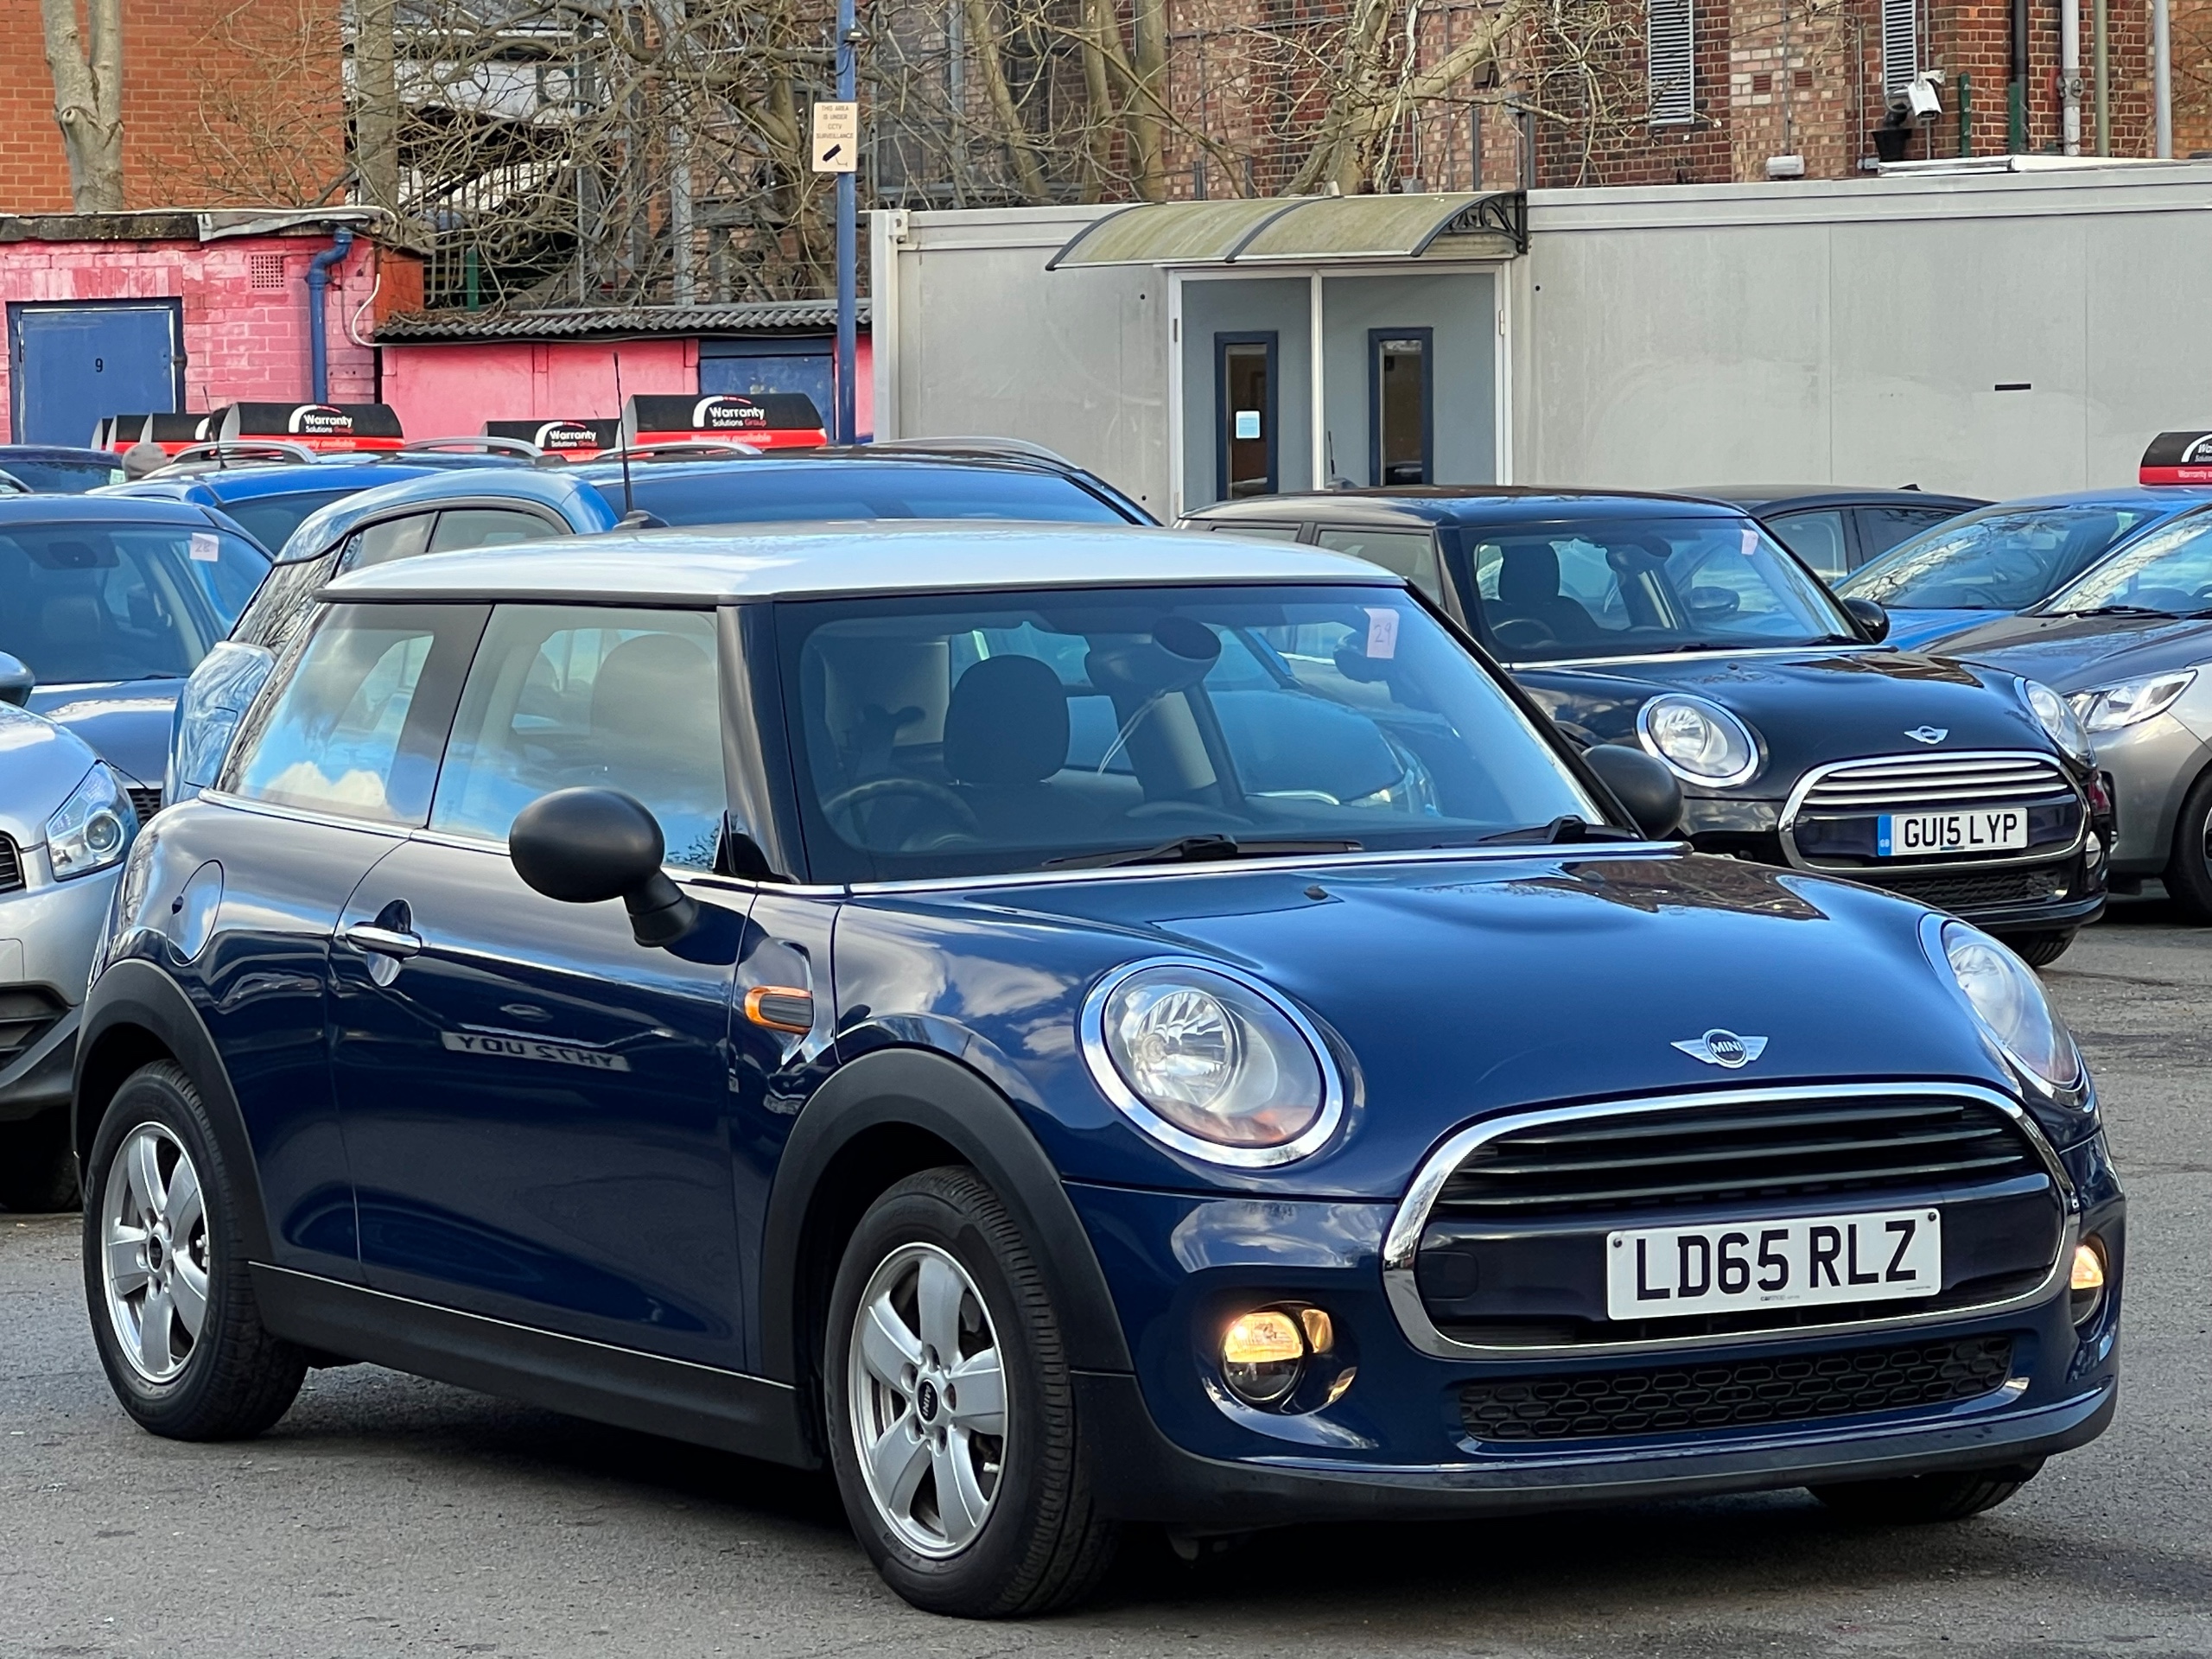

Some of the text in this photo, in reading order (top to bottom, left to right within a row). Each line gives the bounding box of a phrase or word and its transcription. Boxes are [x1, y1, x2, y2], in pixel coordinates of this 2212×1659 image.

[95, 358, 104, 372] 9
[709, 407, 764, 420] Warranty
[303, 415, 353, 428] Warranty
[744, 418, 766, 427] Group
[305, 425, 333, 434] Solutions
[550, 431, 596, 442] Warranty
[1374, 622, 1392, 645] 29
[1904, 813, 2018, 848] GU15 LYP
[1710, 1040, 1745, 1054] MINI
[1637, 1218, 1916, 1301] LD65 RLZ
[922, 1383, 932, 1417] MINI
